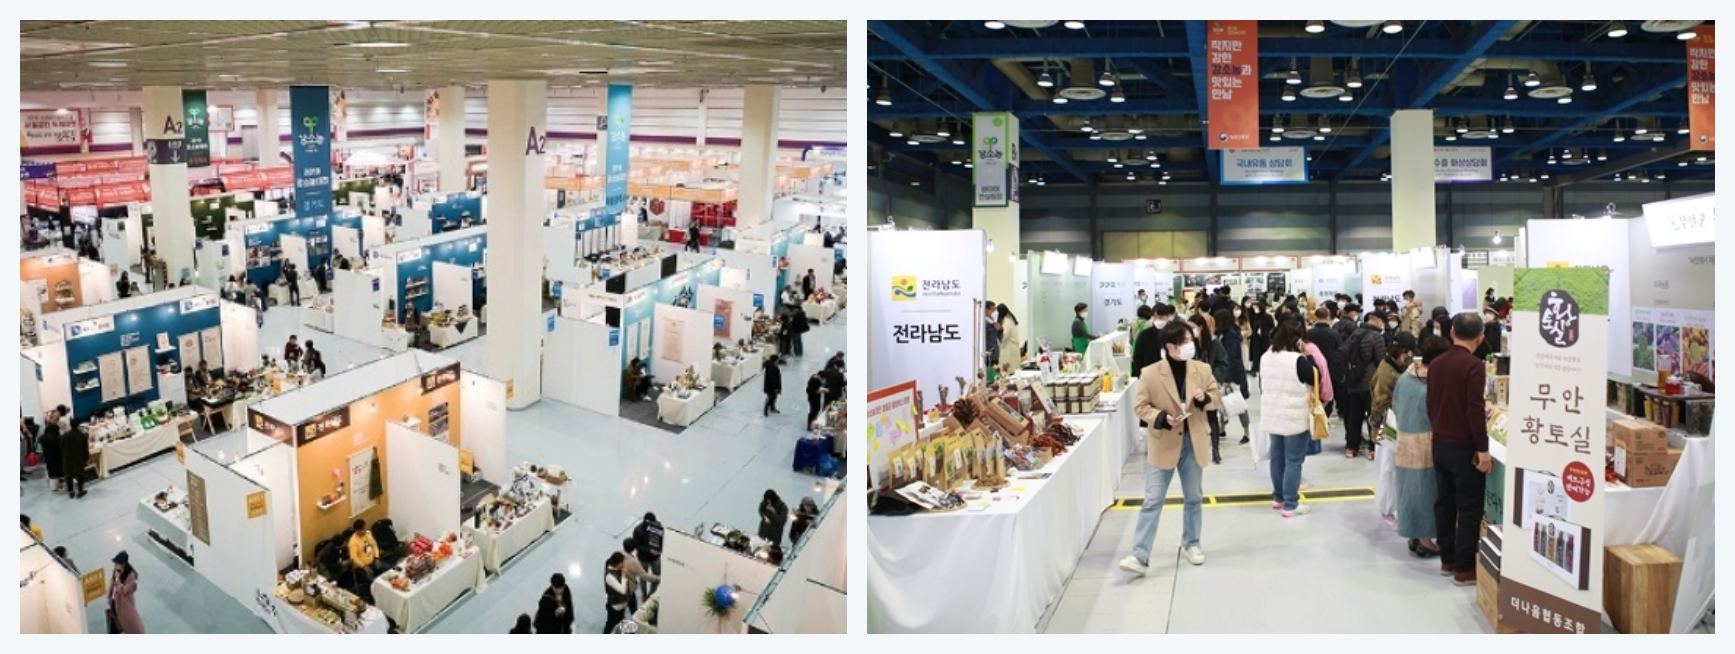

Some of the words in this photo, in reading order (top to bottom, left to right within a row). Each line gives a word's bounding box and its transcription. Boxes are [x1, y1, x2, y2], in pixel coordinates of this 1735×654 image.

[1211, 40, 1242, 52] 작지만
[1212, 52, 1232, 64] 강한
[1691, 58, 1708, 70] 강한
[1212, 64, 1252, 76] 강소농과
[1212, 76, 1242, 88] 맛있는
[1212, 89, 1232, 100] 만남
[1692, 93, 1710, 104] 만남
[163, 115, 183, 135] A2
[525, 126, 546, 155] A2
[978, 149, 1003, 160] 강소농
[1236, 158, 1267, 168] 국내유통
[1269, 158, 1293, 168] 상담회
[1450, 158, 1488, 167] 화상상담회
[922, 279, 961, 291] 전라남도
[893, 323, 961, 344] 전라남도
[1530, 383, 1584, 415] 무안
[1521, 415, 1591, 455] 황토실
